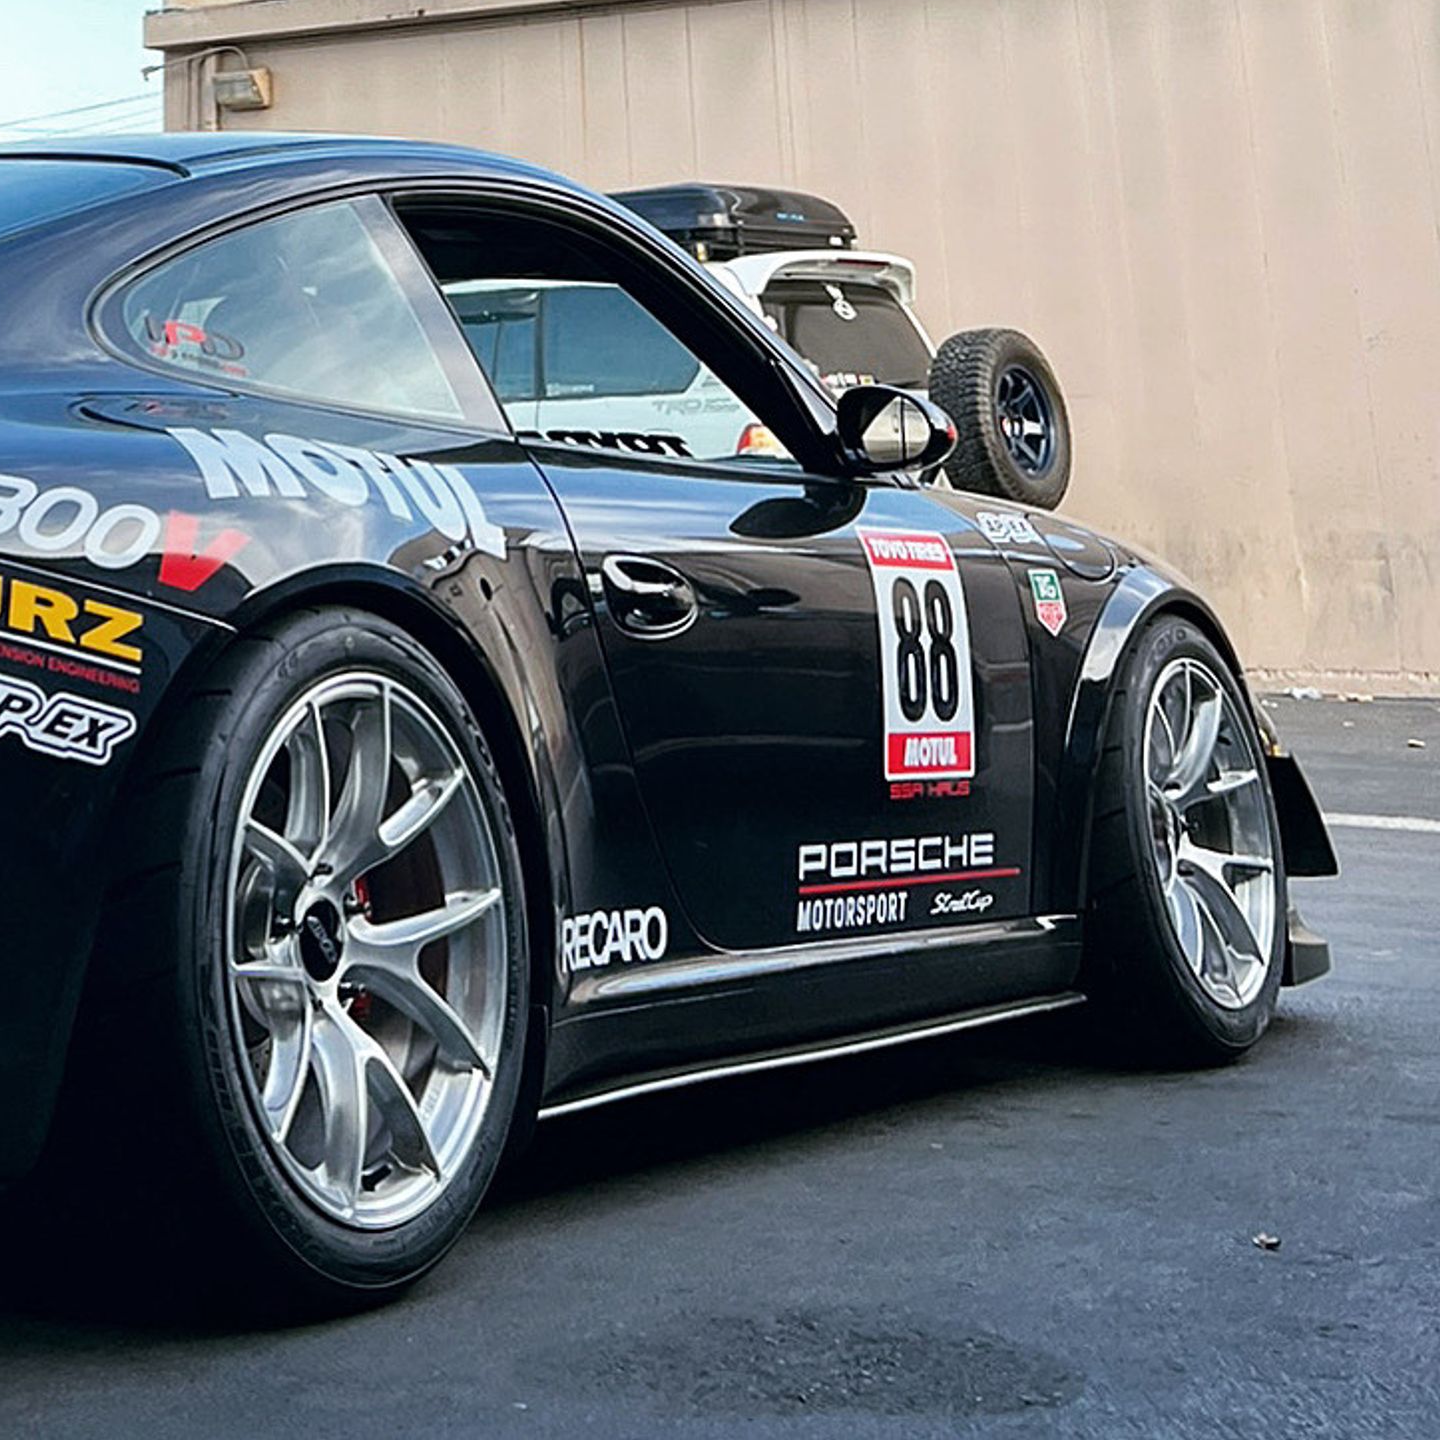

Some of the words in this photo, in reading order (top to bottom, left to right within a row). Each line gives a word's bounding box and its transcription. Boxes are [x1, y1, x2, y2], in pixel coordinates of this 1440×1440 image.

[164, 427, 506, 560] MOTUL
[892, 577, 957, 723] 88
[47, 656, 141, 693] ENGINEERING
[904, 737, 958, 767] MOTUL
[890, 782, 924, 799] SSA
[928, 780, 970, 797] HAUS
[799, 832, 994, 881] PORSCHE
[797, 891, 908, 931] MOTORSPORT
[562, 906, 668, 973] RECARO
